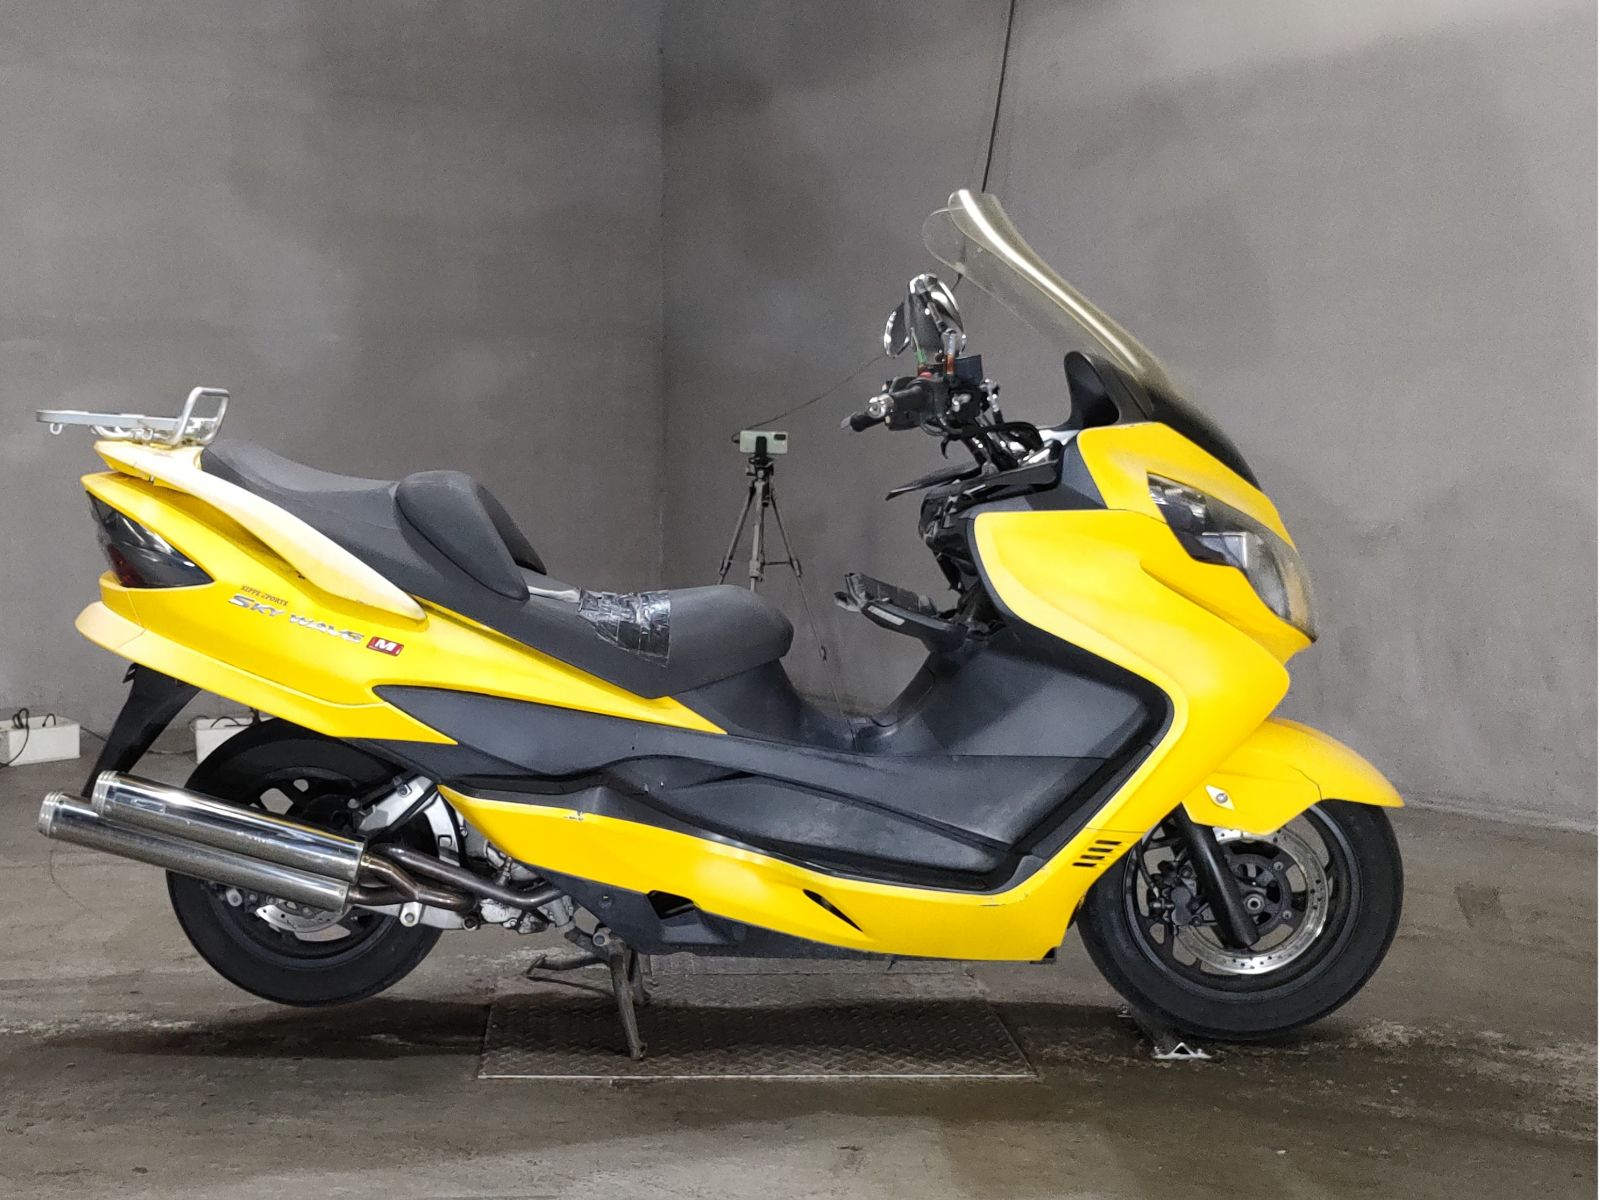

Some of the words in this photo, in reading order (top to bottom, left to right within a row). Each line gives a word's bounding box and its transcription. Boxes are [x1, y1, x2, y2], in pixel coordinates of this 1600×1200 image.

[228, 594, 286, 617] SKY
[289, 614, 365, 643] WAVE
[374, 638, 397, 652] M
